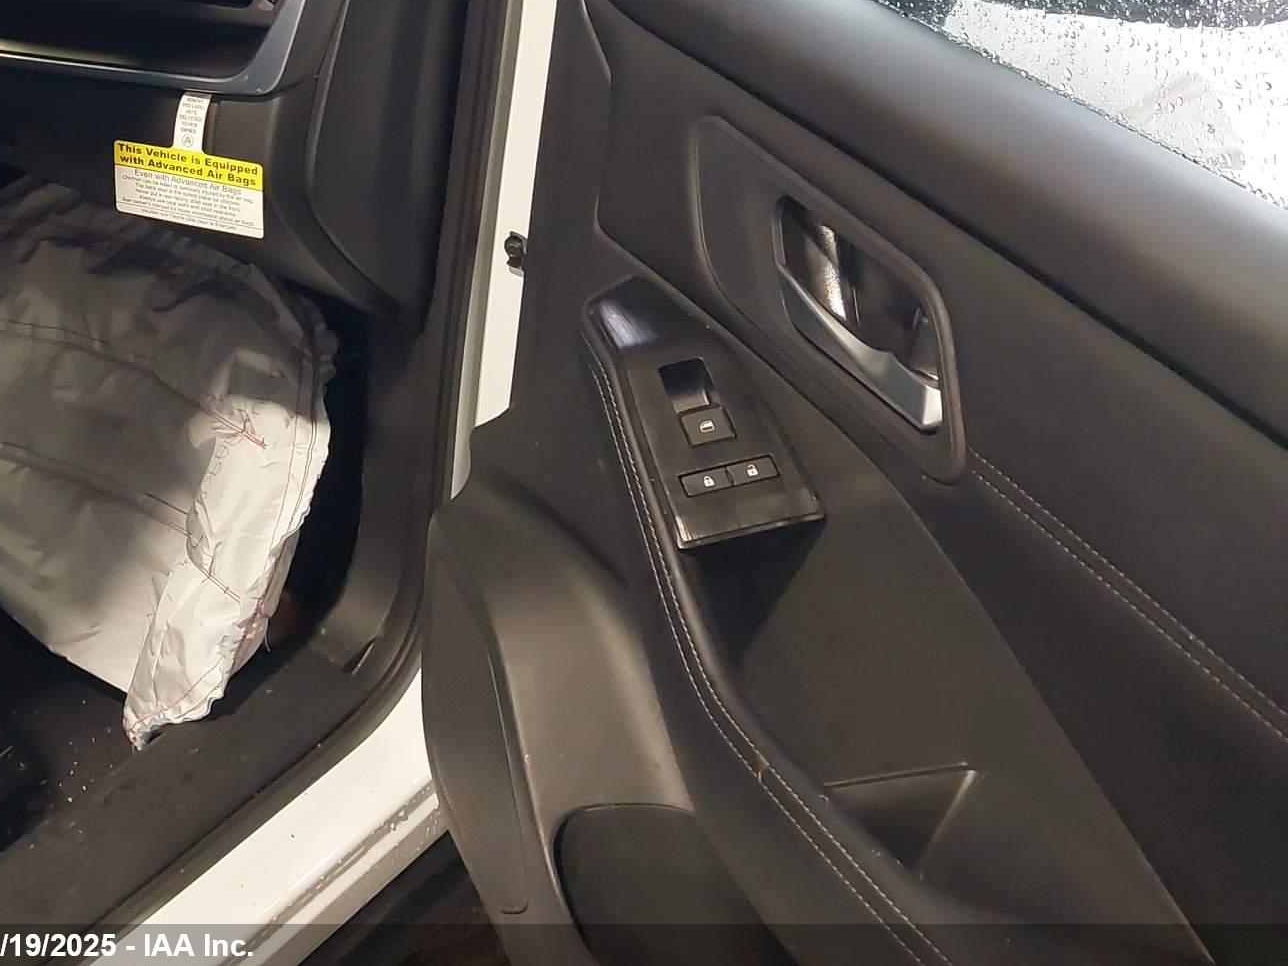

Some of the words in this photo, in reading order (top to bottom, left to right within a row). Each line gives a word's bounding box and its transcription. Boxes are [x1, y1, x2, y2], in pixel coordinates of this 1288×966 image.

[118, 143, 142, 155] This
[146, 147, 187, 162] Vehicle
[192, 155, 200, 164] is
[205, 158, 257, 175] Equipped
[120, 155, 144, 165] with
[148, 159, 202, 176] Advanced
[207, 170, 223, 180] Air
[228, 173, 256, 186] Bags
[135, 169, 152, 178] Even
[155, 174, 169, 182] with
[171, 176, 207, 189] Advanced
[222, 185, 241, 195] Bags
